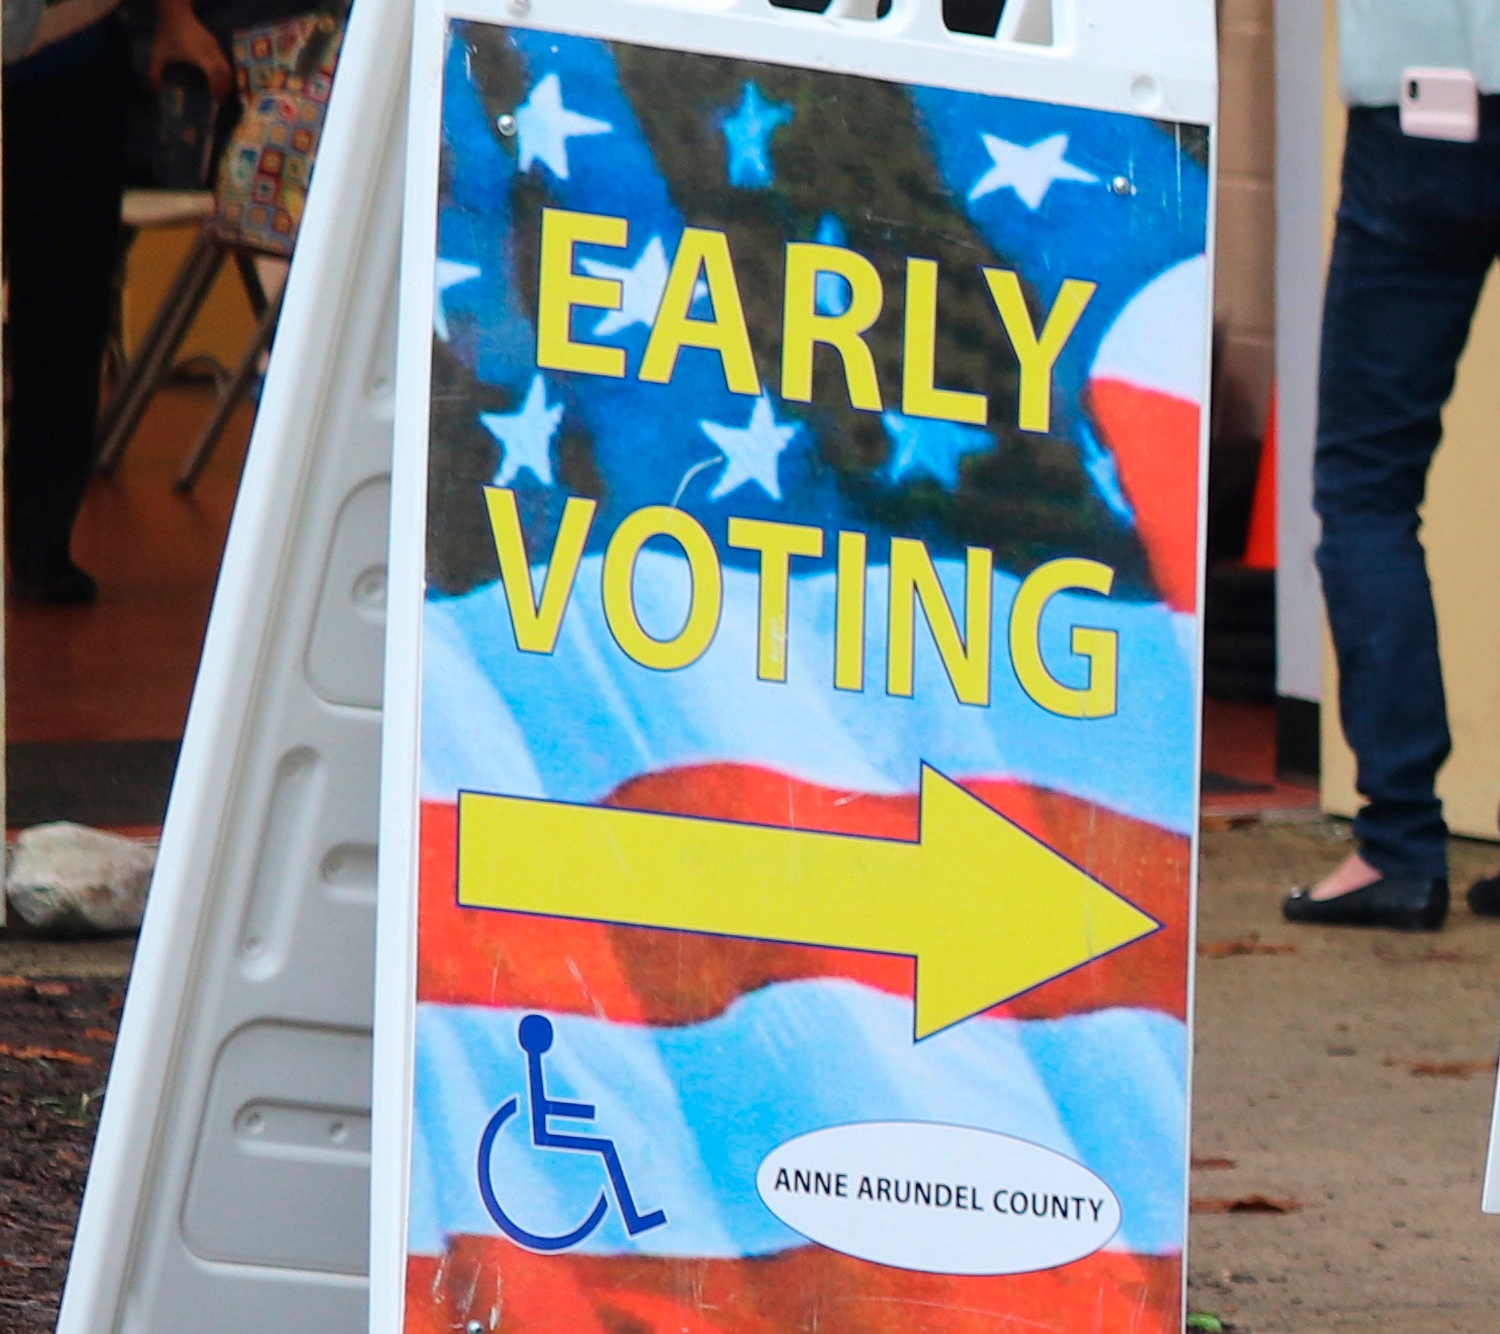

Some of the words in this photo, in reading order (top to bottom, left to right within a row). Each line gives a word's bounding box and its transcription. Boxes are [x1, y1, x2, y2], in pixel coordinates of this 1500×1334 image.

[535, 208, 1097, 434] EARLY
[484, 486, 1119, 719] VOTING
[774, 1168, 848, 1197] ANNE
[857, 1176, 984, 1212] ARUNDEL
[993, 1189, 1104, 1222] COUNTY
